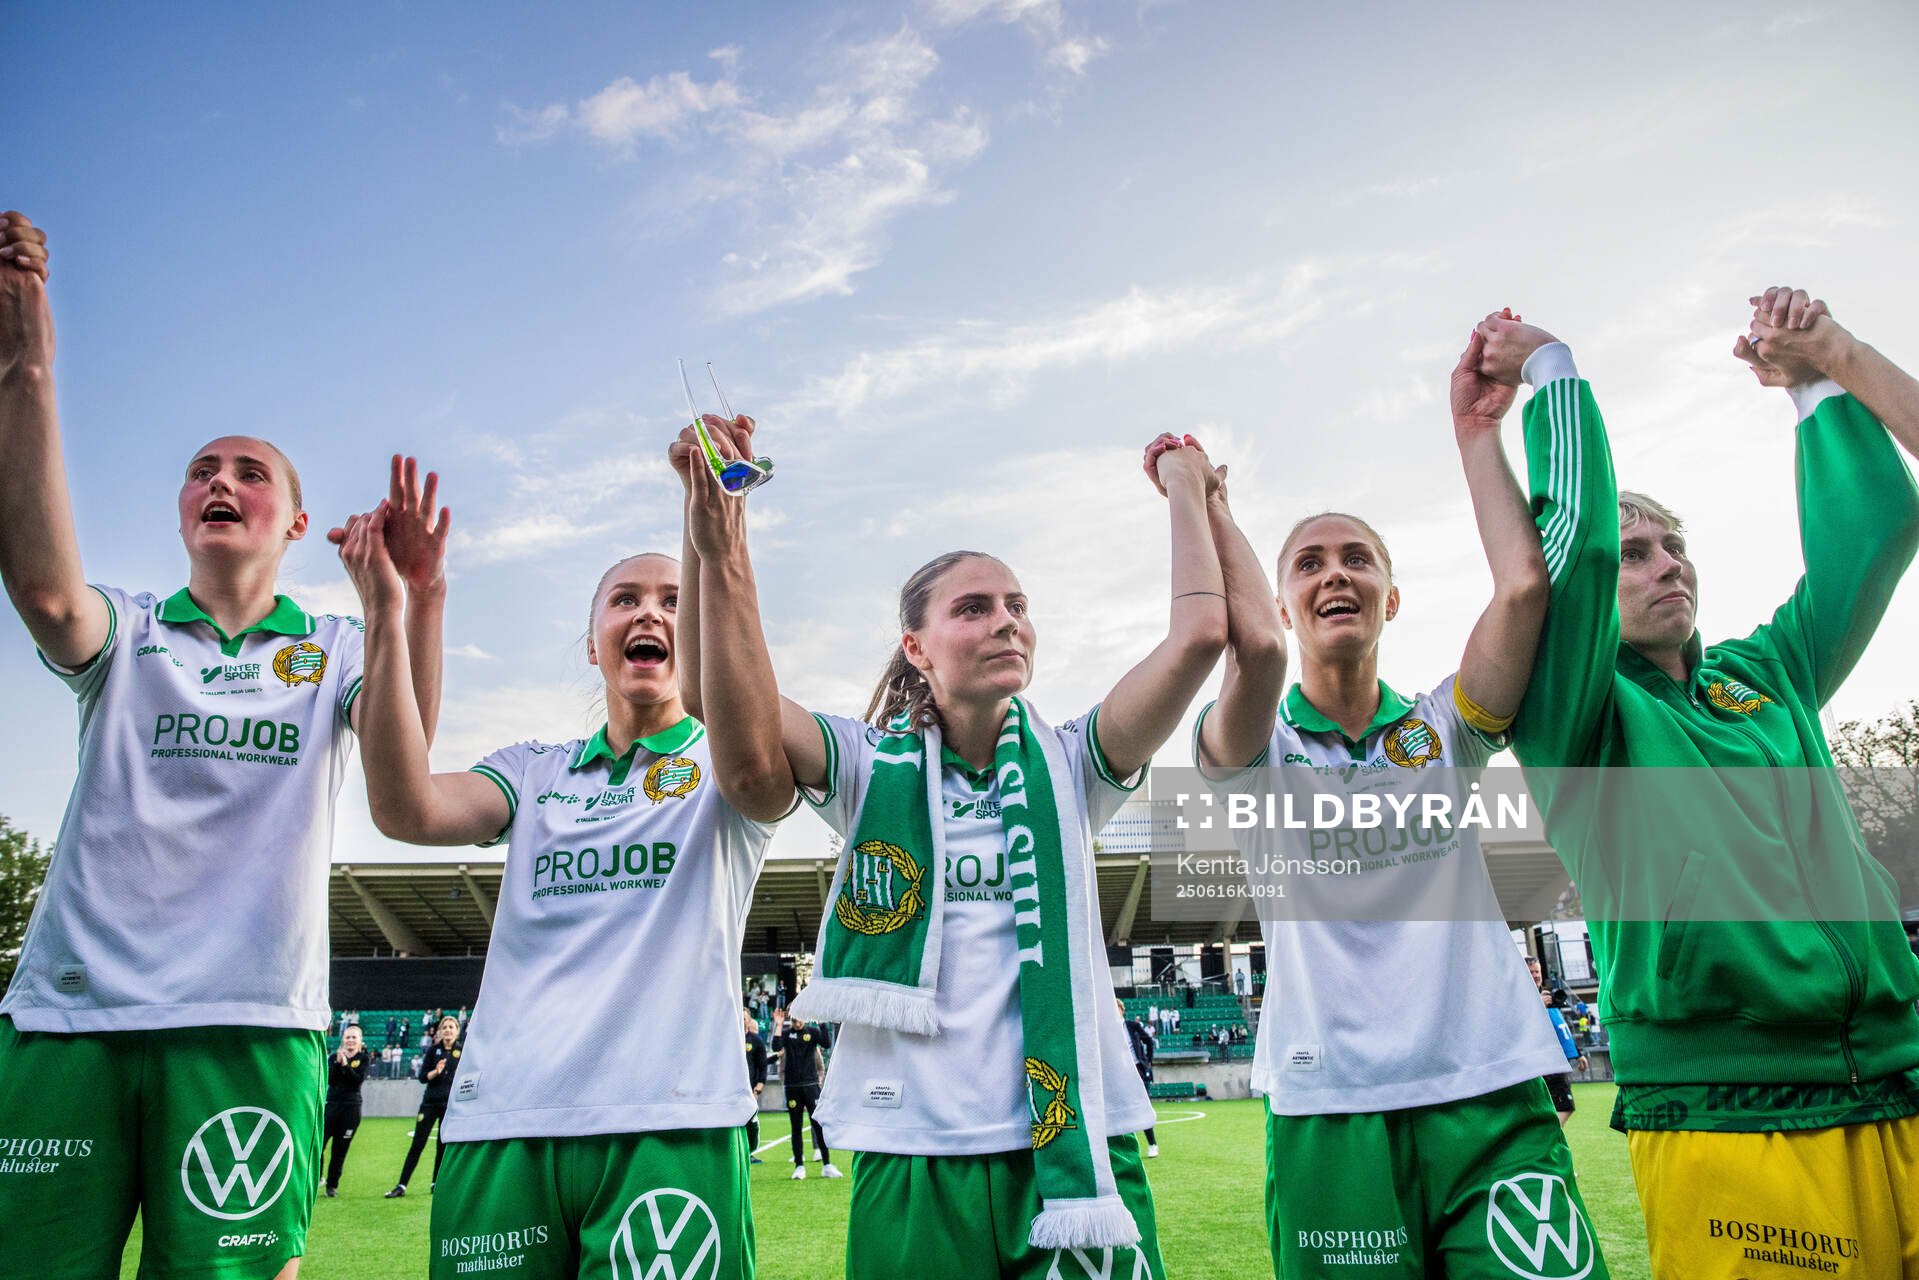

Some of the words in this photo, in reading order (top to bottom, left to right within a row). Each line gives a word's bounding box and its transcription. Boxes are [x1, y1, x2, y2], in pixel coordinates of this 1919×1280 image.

[136, 644, 169, 657] CRAF
[224, 664, 260, 673] INTER
[224, 671, 260, 682] SPORT
[152, 712, 300, 754] PROJOB
[151, 748, 234, 762] PROFESSIONAL
[236, 752, 298, 767] WORKWEAR
[976, 799, 1001, 809] INTE
[533, 841, 677, 888] PROJOB
[532, 881, 608, 901] PROFESSIONAL
[609, 878, 667, 890] WORKWEA
[0, 1137, 94, 1157] PHORUS
[0, 1156, 60, 1173] kluster
[218, 1233, 268, 1248] CRAFT
[441, 1225, 549, 1257] BOSPHORUS
[1298, 1226, 1408, 1249] BOSPHORUS
[1708, 1218, 1861, 1259] BOSPHORUS
[456, 1251, 525, 1274] matkluster
[1323, 1248, 1400, 1265] matkluster
[1743, 1245, 1839, 1274] matkluster
